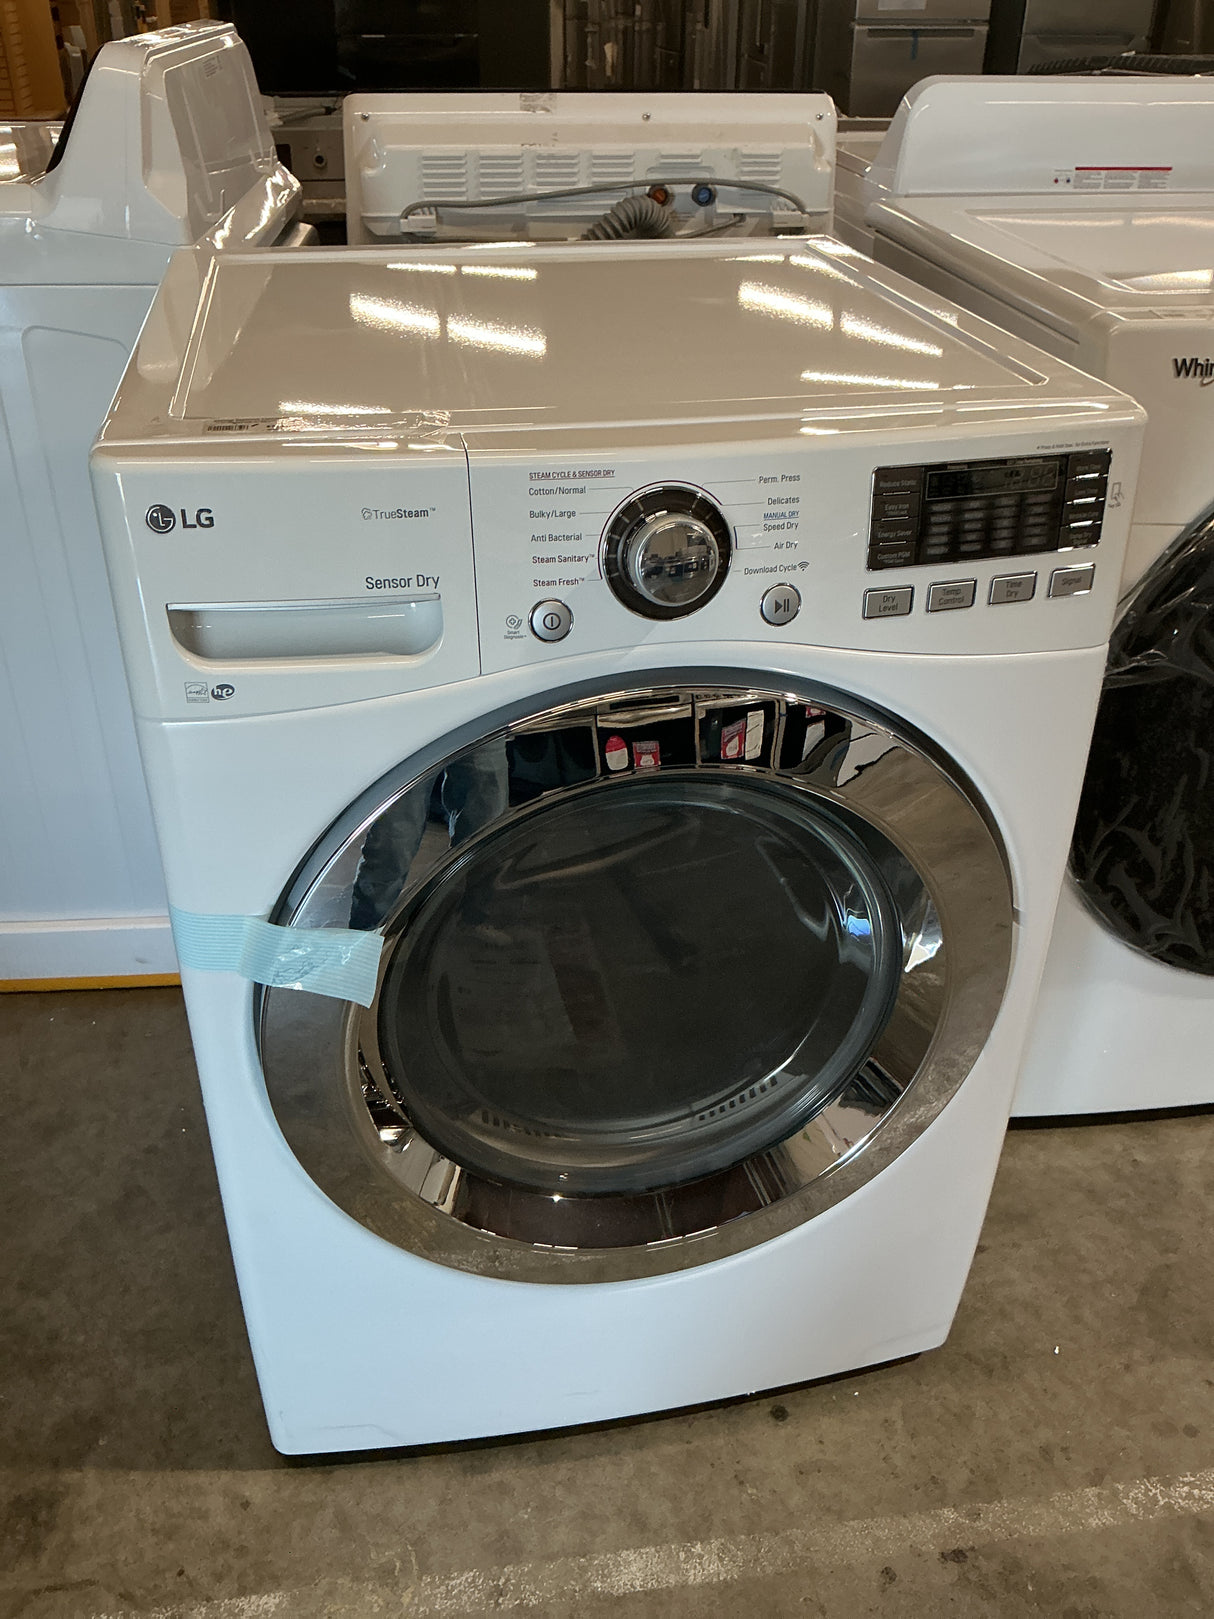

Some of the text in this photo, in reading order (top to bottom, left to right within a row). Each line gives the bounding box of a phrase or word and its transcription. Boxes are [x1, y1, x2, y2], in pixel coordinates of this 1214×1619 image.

[529, 472, 551, 480] STEAM
[552, 471, 571, 479] CYCLE
[578, 470, 601, 478] SENSOR
[603, 469, 615, 477] DRY
[758, 474, 801, 484] Perm. Press
[528, 486, 587, 496] Cotton/Normal
[767, 496, 800, 506] Delicates
[180, 508, 215, 529] LG
[529, 510, 577, 519] Bulky/Large
[763, 510, 800, 520] MANUAL DRY
[763, 521, 799, 532] Speed Dry
[530, 533, 582, 542] Anti Bacterial
[785, 541, 798, 550] Dry
[532, 555, 556, 564] Steam
[744, 564, 797, 575] Download Cycle
[365, 574, 440, 590] Sensor Dry
[533, 579, 557, 587] Steam
[942, 588, 962, 597] Temp
[1006, 590, 1019, 598] Dry
[882, 595, 896, 604] Dry
[938, 596, 965, 606] Control
[879, 604, 899, 613] Level
